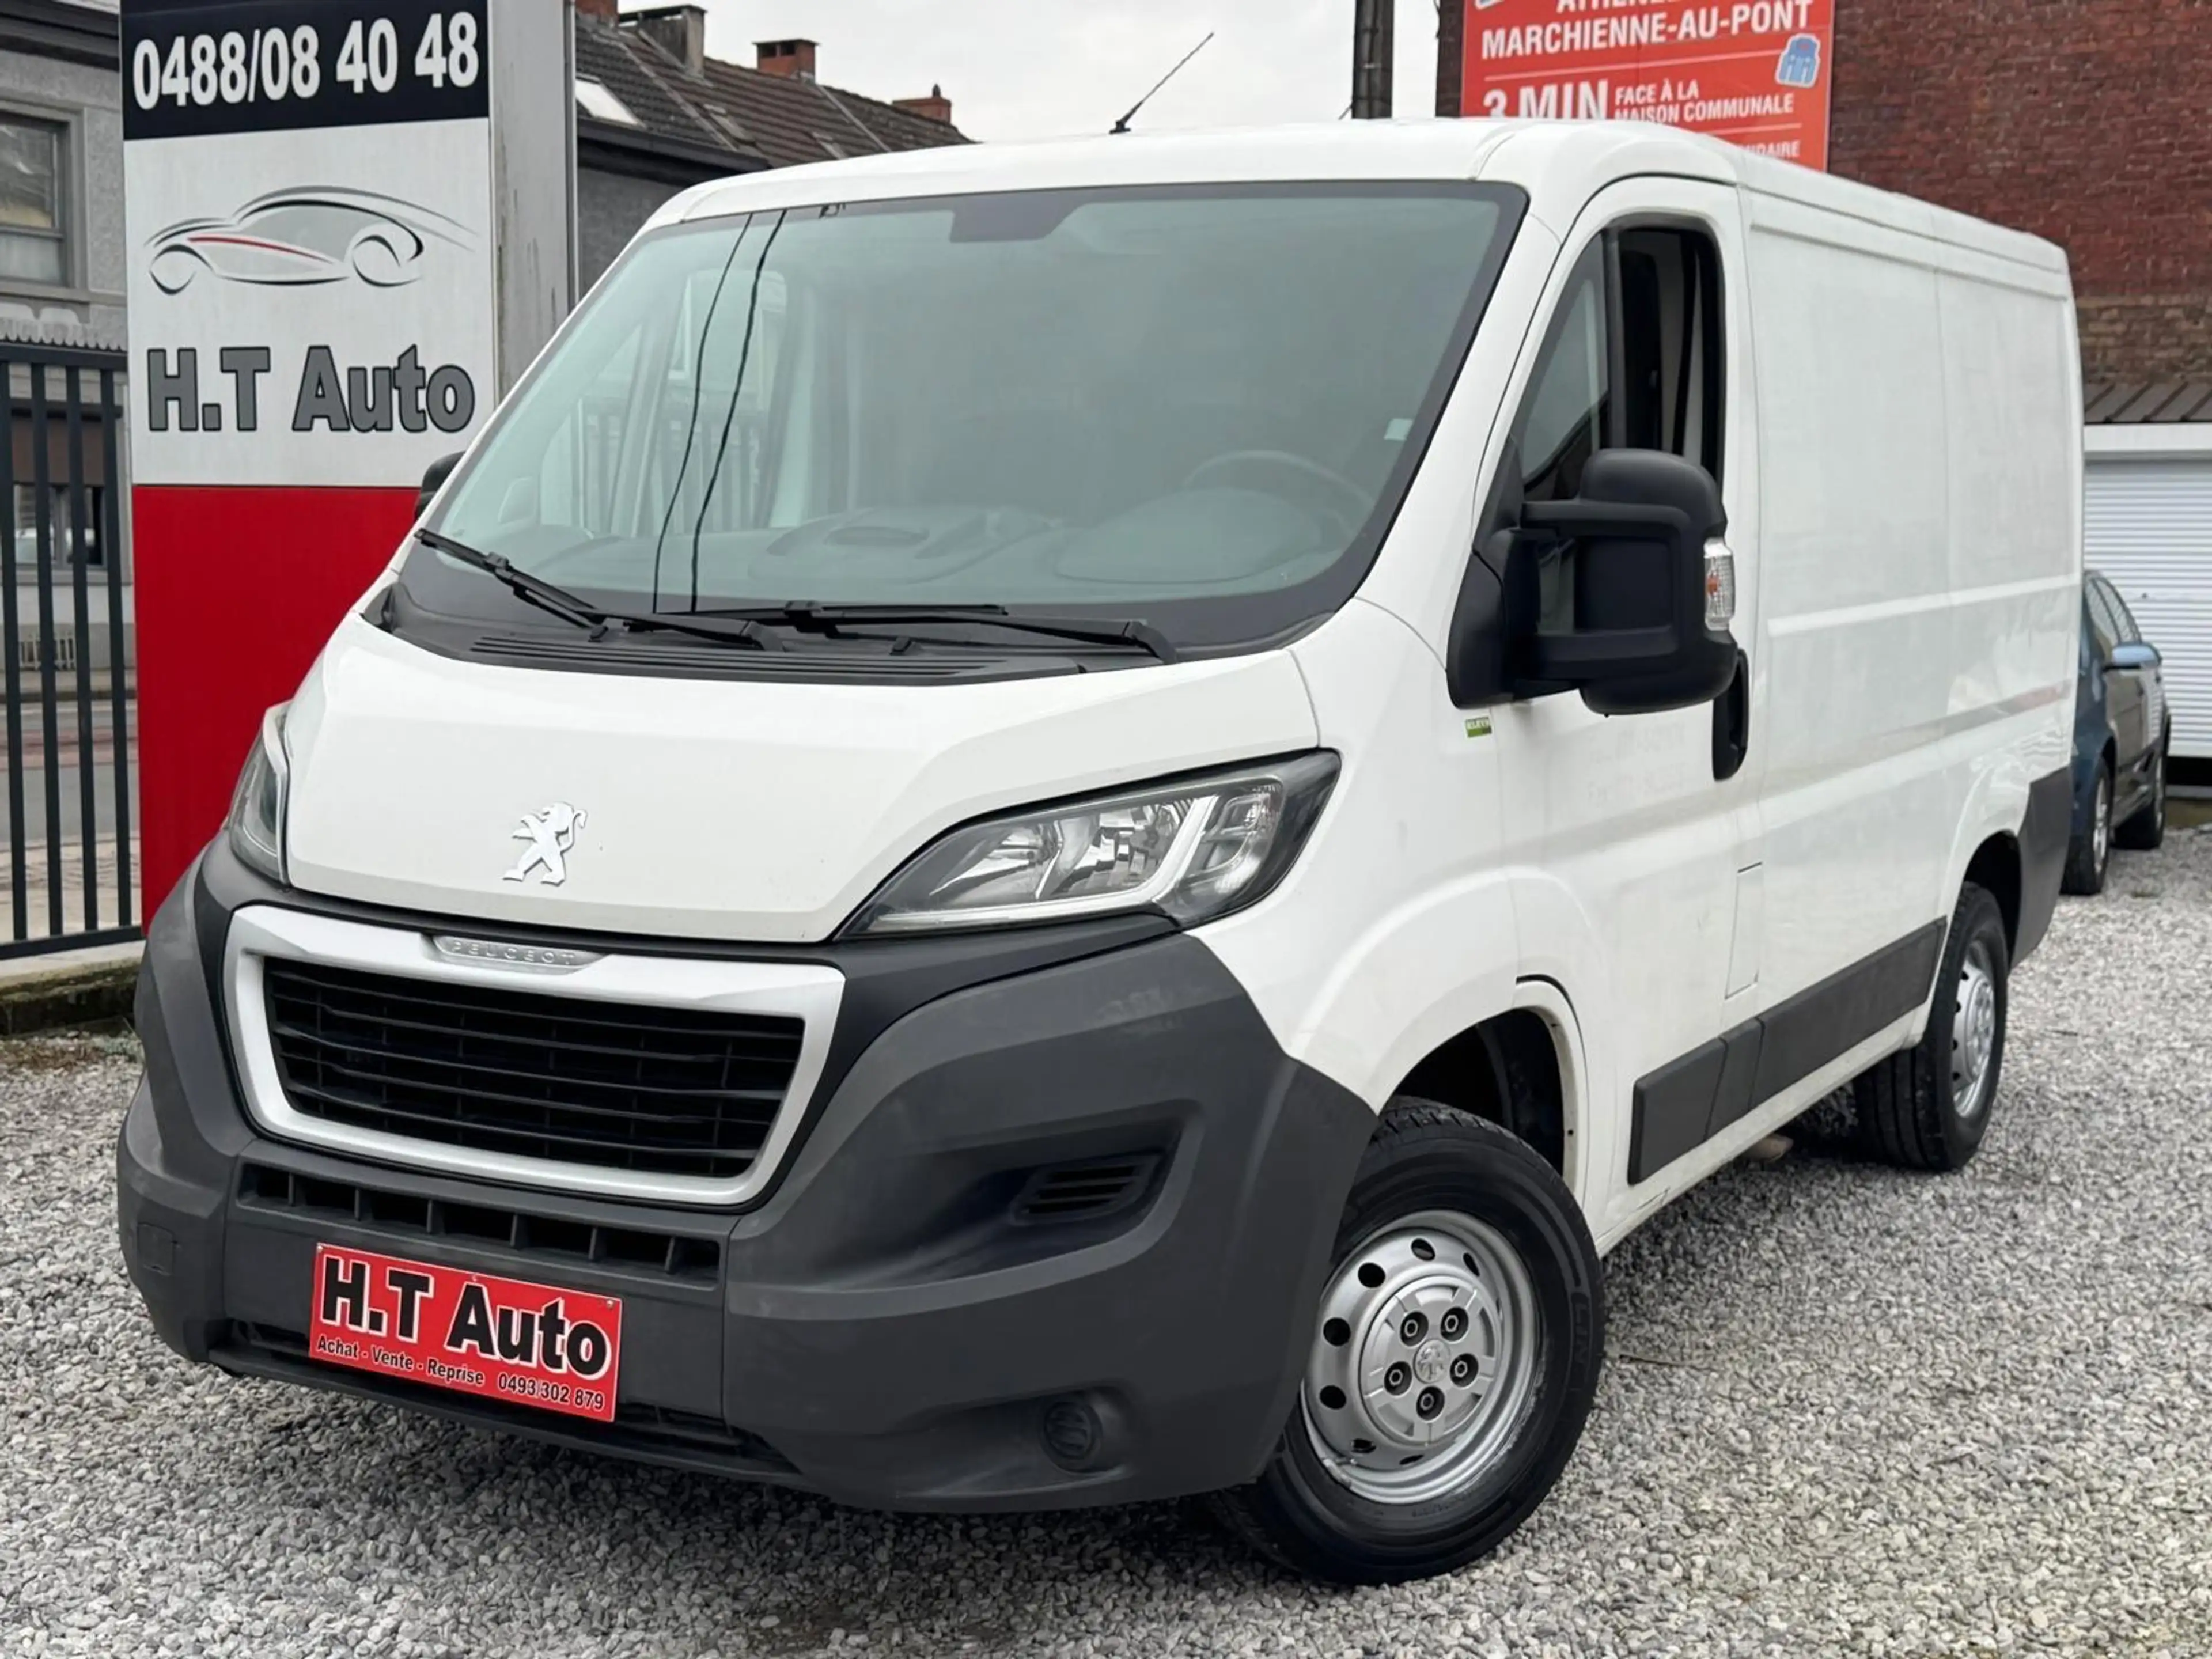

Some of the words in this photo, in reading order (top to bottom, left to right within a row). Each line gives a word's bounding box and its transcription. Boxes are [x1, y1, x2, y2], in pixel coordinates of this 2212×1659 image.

[133, 25, 320, 110] 0488/08
[336, 18, 397, 93] 40
[414, 12, 478, 87] 48
[1482, 0, 1812, 59] MARCHIENNE-AU-PONT
[1519, 79, 1608, 119] MIN
[1615, 83, 1656, 105] FACE
[1677, 79, 1699, 100] LA
[1683, 93, 1794, 123] COMMUNALE
[147, 347, 271, 431] H.T
[291, 344, 475, 433] Auto
[320, 1254, 434, 1343] H.T
[444, 1280, 612, 1381] Auto
[317, 1335, 358, 1358] Achat
[372, 1346, 413, 1370] Vente
[427, 1358, 485, 1385] Reprise
[575, 1388, 604, 1410] 879
